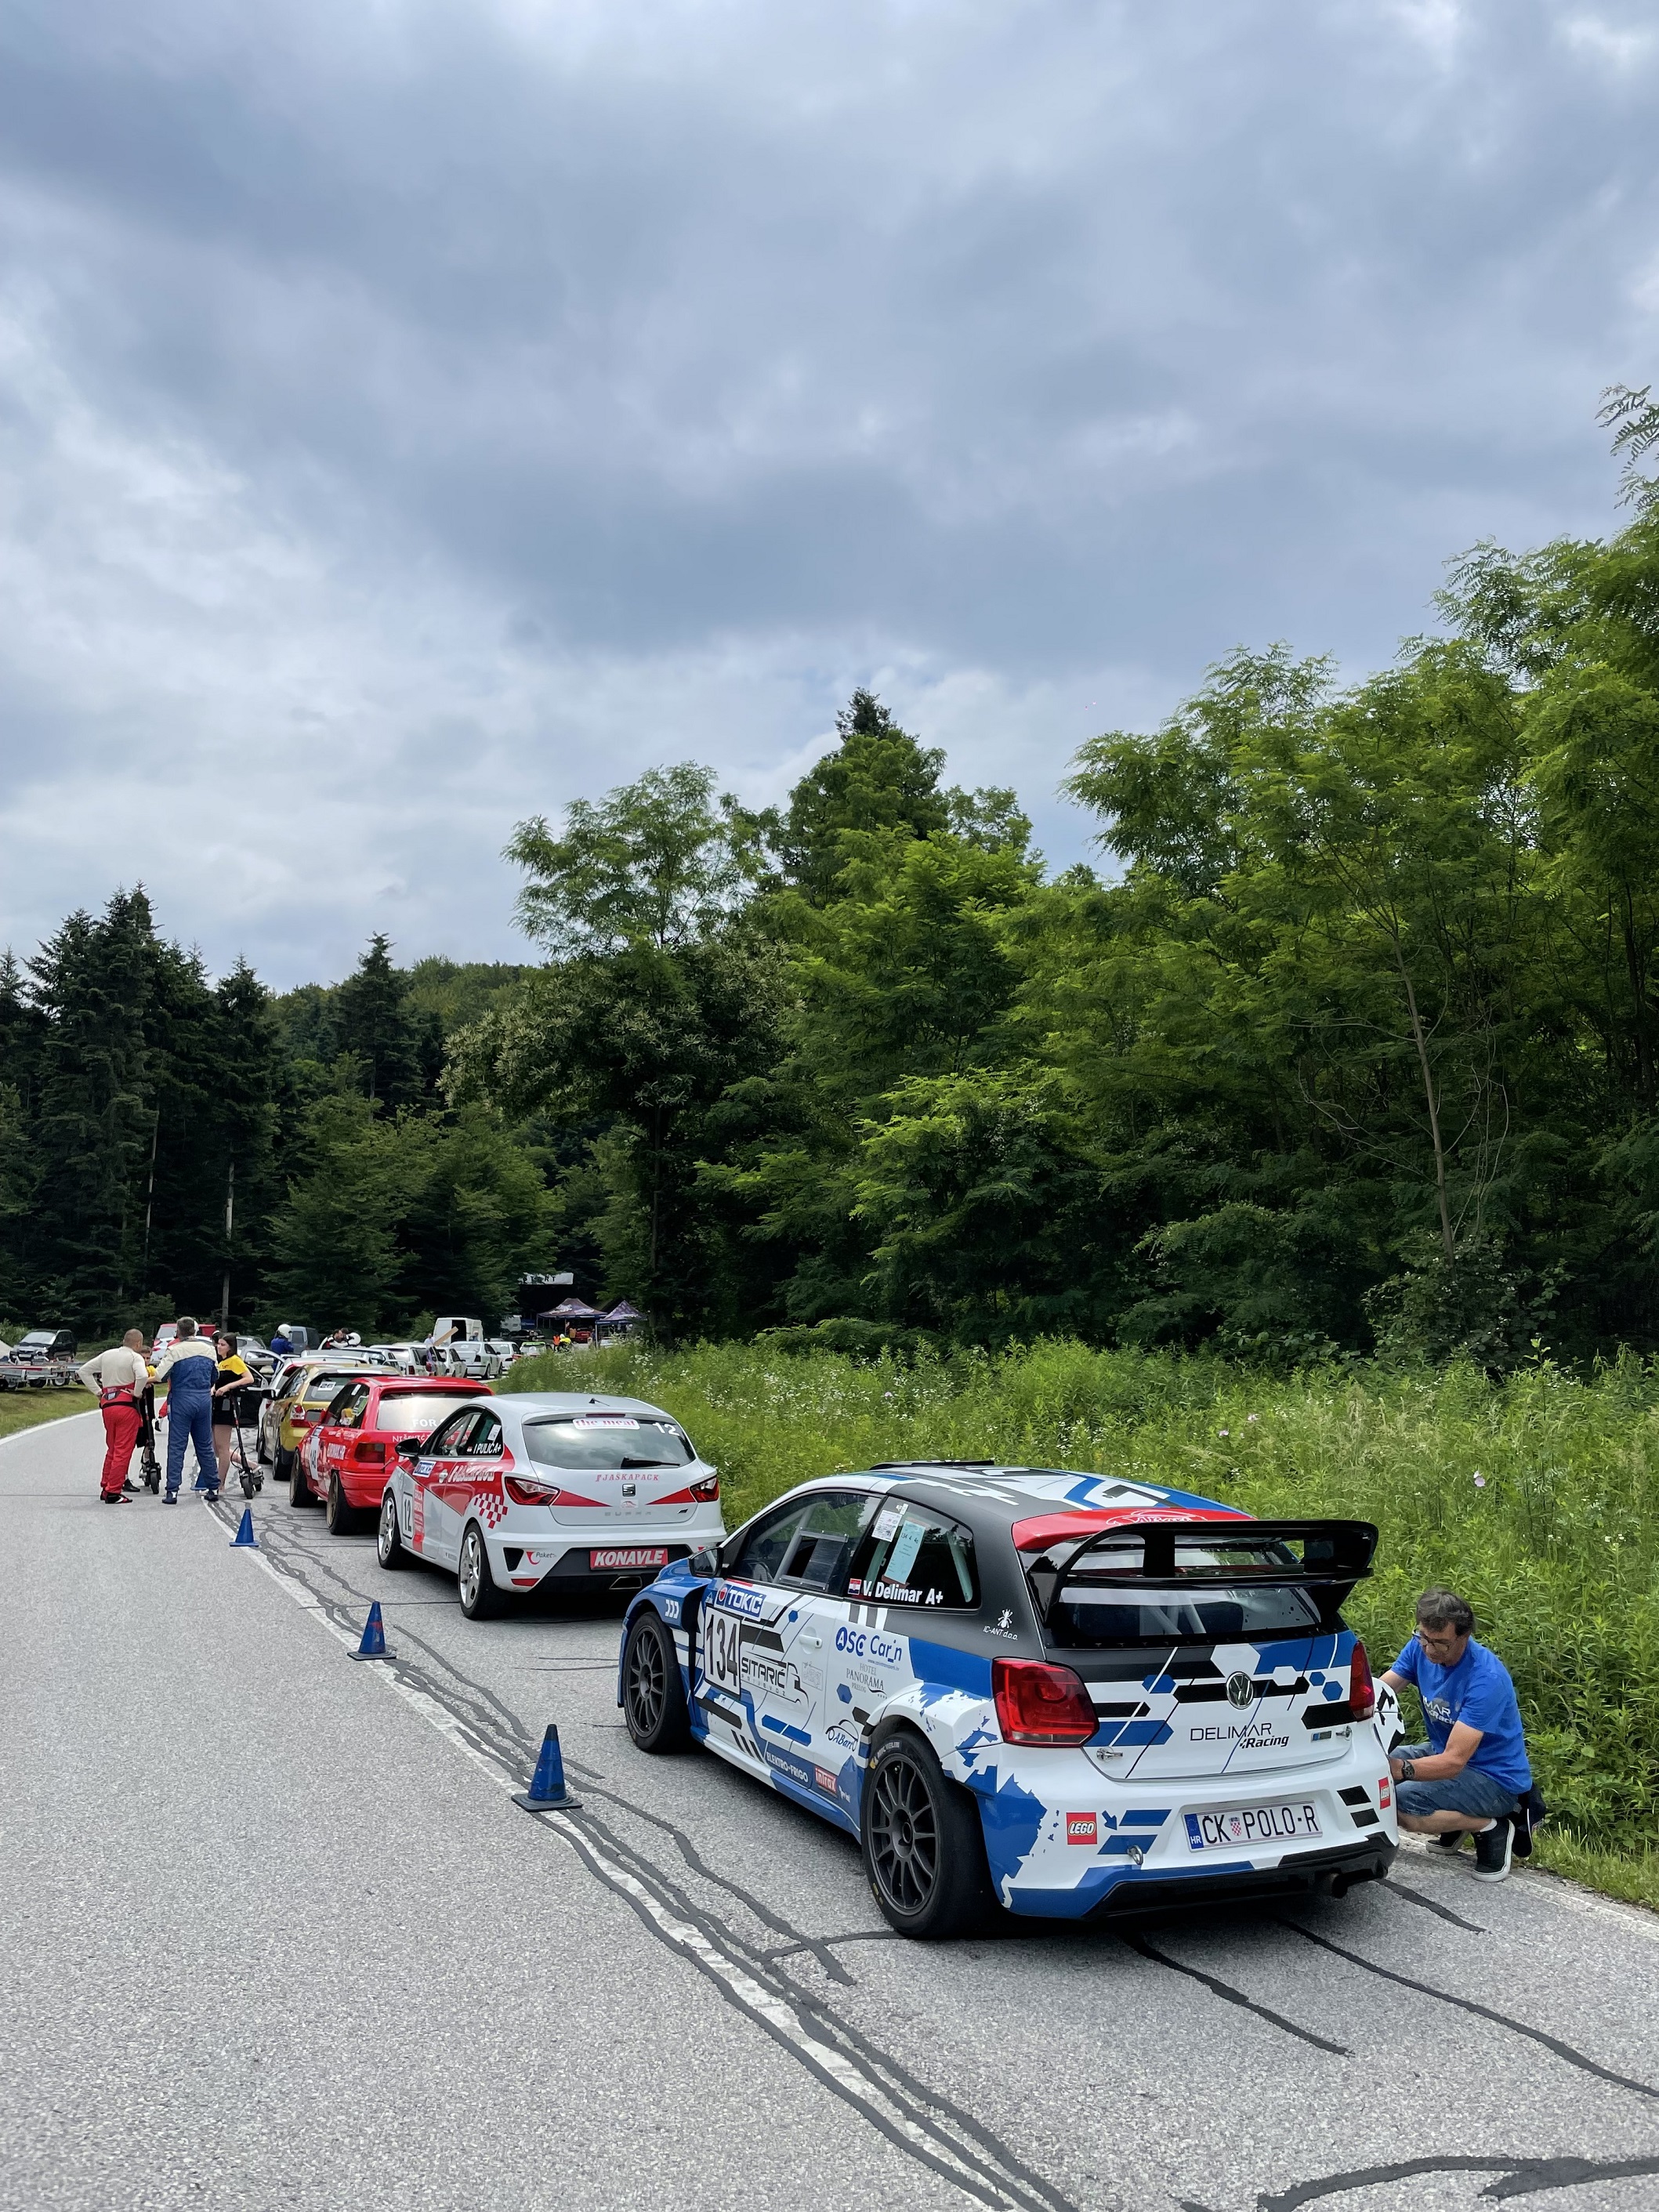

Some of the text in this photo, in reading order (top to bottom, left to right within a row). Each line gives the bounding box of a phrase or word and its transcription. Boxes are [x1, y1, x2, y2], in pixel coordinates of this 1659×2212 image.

[412, 1418, 436, 1427] FOR
[652, 1421, 680, 1436] 12
[594, 1550, 665, 1566] KONAVLE
[728, 1589, 763, 1614] TOKIĆ
[863, 1580, 944, 1605] V. Delimar A+
[706, 1613, 738, 1687] 134
[741, 1656, 786, 1689] SITARIĆ
[846, 1667, 884, 1691] PANORAMA
[859, 1663, 877, 1676] HOTEL
[1190, 1722, 1273, 1741] DELIMAR
[1244, 1735, 1290, 1748] Racing
[1068, 1821, 1096, 1835] LEGO
[1190, 1805, 1320, 1845] HR ČK POLO-R
